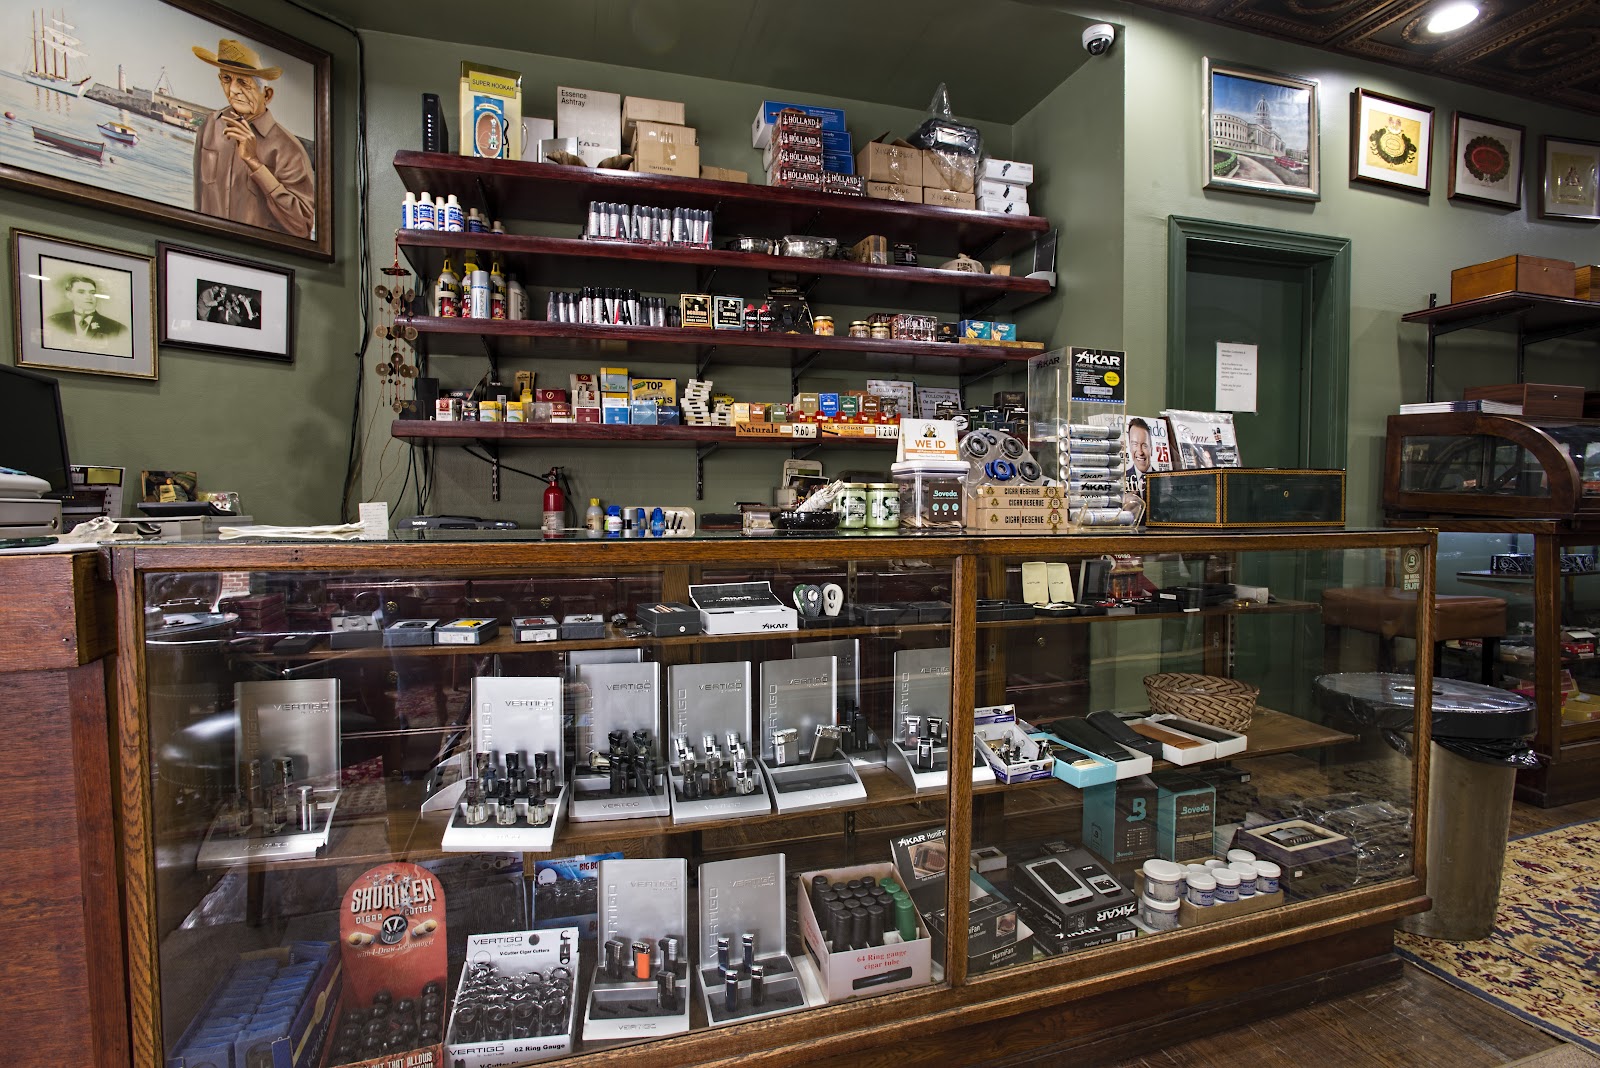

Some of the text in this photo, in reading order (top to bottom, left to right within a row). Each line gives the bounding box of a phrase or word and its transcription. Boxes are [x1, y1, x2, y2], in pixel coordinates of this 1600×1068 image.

[472, 79, 514, 92] SUPER HOOKAH
[561, 89, 587, 100] Essence
[561, 98, 586, 108] Ashtray
[788, 115, 816, 126] HOLLAND
[789, 134, 817, 144] HOLLAND
[789, 153, 817, 163] HOLLAND
[787, 170, 815, 180] HOLLAND
[831, 174, 858, 185] HOLLAND
[1036, 356, 1060, 370] XIKAR
[1075, 351, 1120, 366] XIKAR
[646, 381, 663, 390] TOP
[739, 424, 778, 434] Naturals
[915, 440, 946, 449] WE ID
[1156, 446, 1169, 463] 25
[1081, 482, 1112, 491] XIKAR
[932, 489, 958, 498] Boveda
[1008, 499, 1023, 507] CIGAR
[1023, 499, 1045, 507] RESERVE
[1004, 516, 1020, 524] CIGAR
[1021, 516, 1044, 524] RESERVE
[1404, 582, 1420, 590] ENJOY
[606, 683, 652, 692] VERTIGO
[698, 682, 743, 692] VERTIGO
[274, 702, 330, 712] VERTIGO
[504, 700, 554, 708] VERTIGO
[1180, 803, 1210, 815] Boveda
[897, 834, 926, 848] XIKAR
[1116, 850, 1134, 858] Boveda
[579, 863, 590, 871] BIG
[351, 878, 436, 913] SHURIKEN
[404, 905, 433, 916] CUTTER
[1096, 903, 1136, 922] XIKAR
[356, 914, 383, 925] CIGAR
[474, 935, 523, 946] VERTIGO
[857, 955, 866, 963] 64
[886, 950, 907, 959] gauge
[992, 947, 1014, 961] HumiFan
[864, 962, 882, 970] cigar
[449, 1045, 505, 1056] VERTIGO
[387, 1059, 404, 1068] THAT
[406, 1052, 433, 1067] ALLOWS
